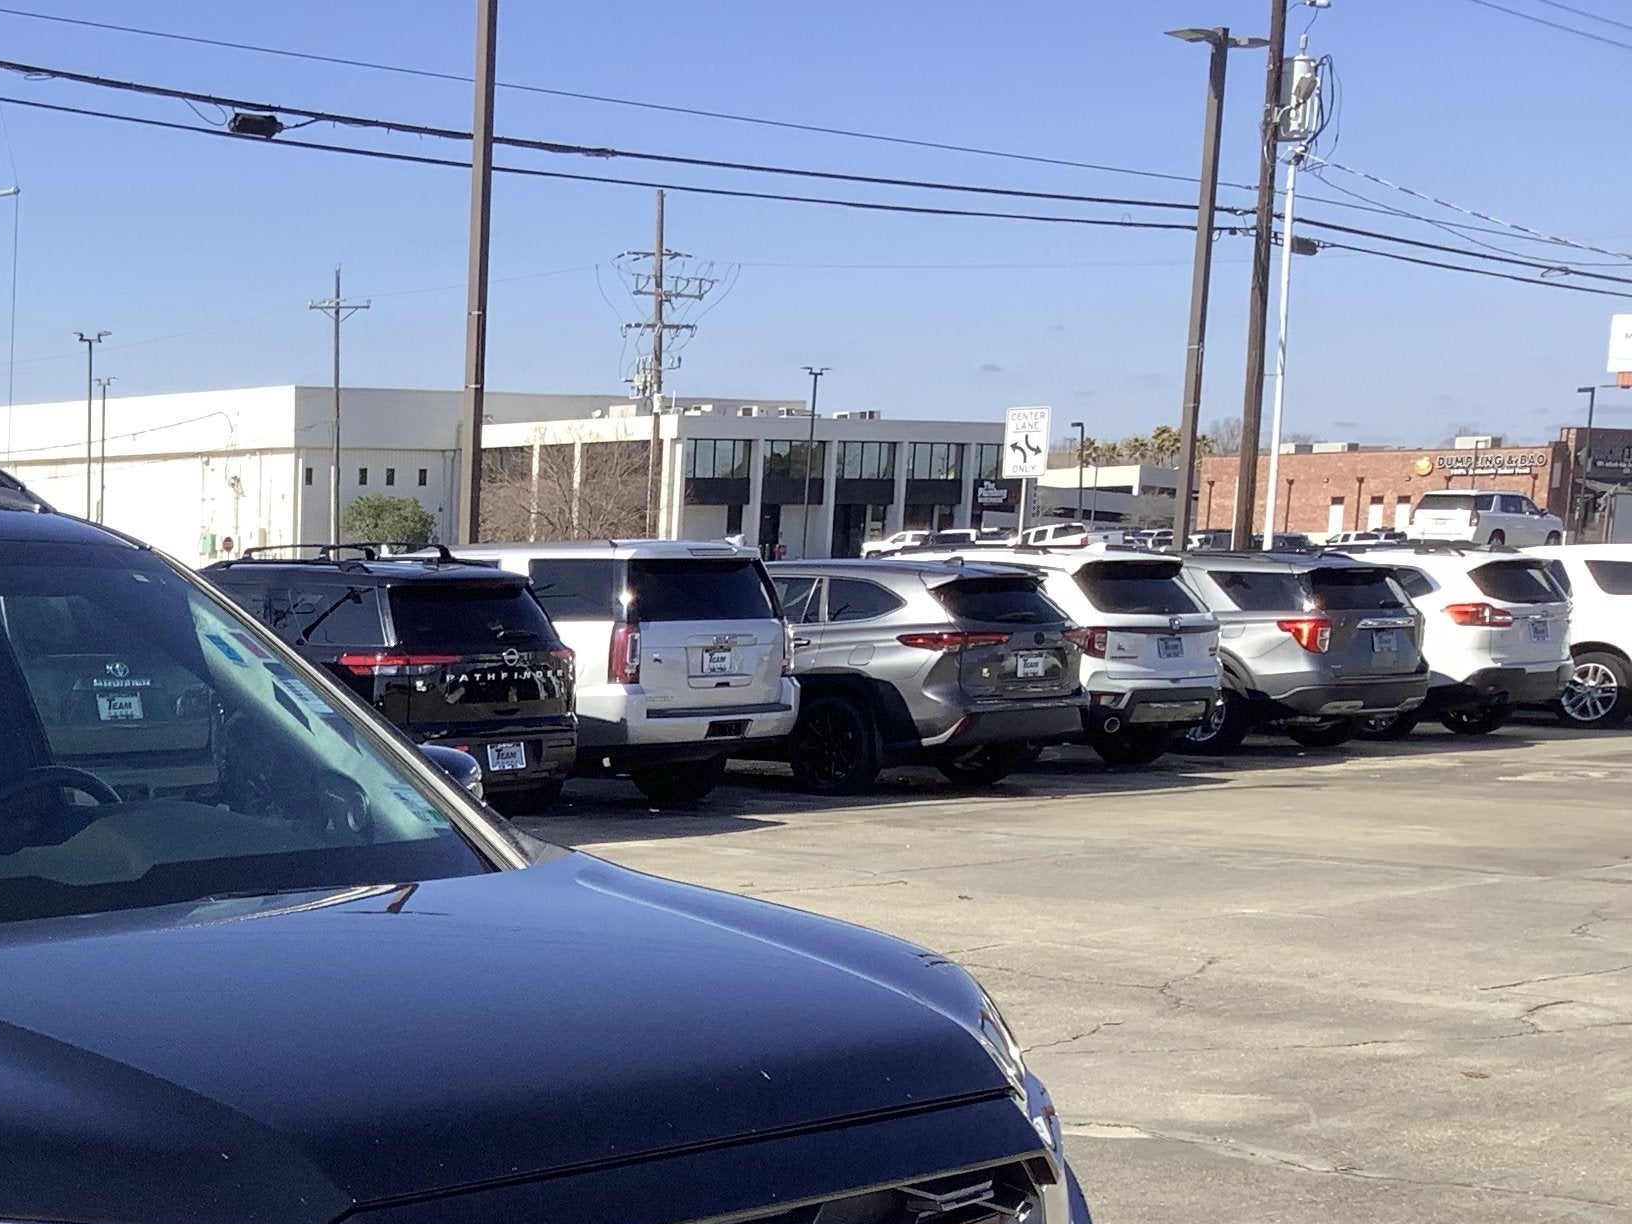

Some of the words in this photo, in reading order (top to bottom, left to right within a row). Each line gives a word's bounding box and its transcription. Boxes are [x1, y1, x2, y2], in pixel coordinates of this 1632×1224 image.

[1011, 411, 1046, 421] CENTER
[1015, 422, 1040, 431] LANE
[1437, 454, 1503, 468] DUMPING
[1506, 454, 1518, 466] &
[1519, 453, 1548, 466] BAO
[1012, 465, 1037, 474] ONLY
[708, 652, 727, 664] TEAM
[446, 669, 564, 682] PATHFINDER
[495, 748, 517, 761] TEAM
